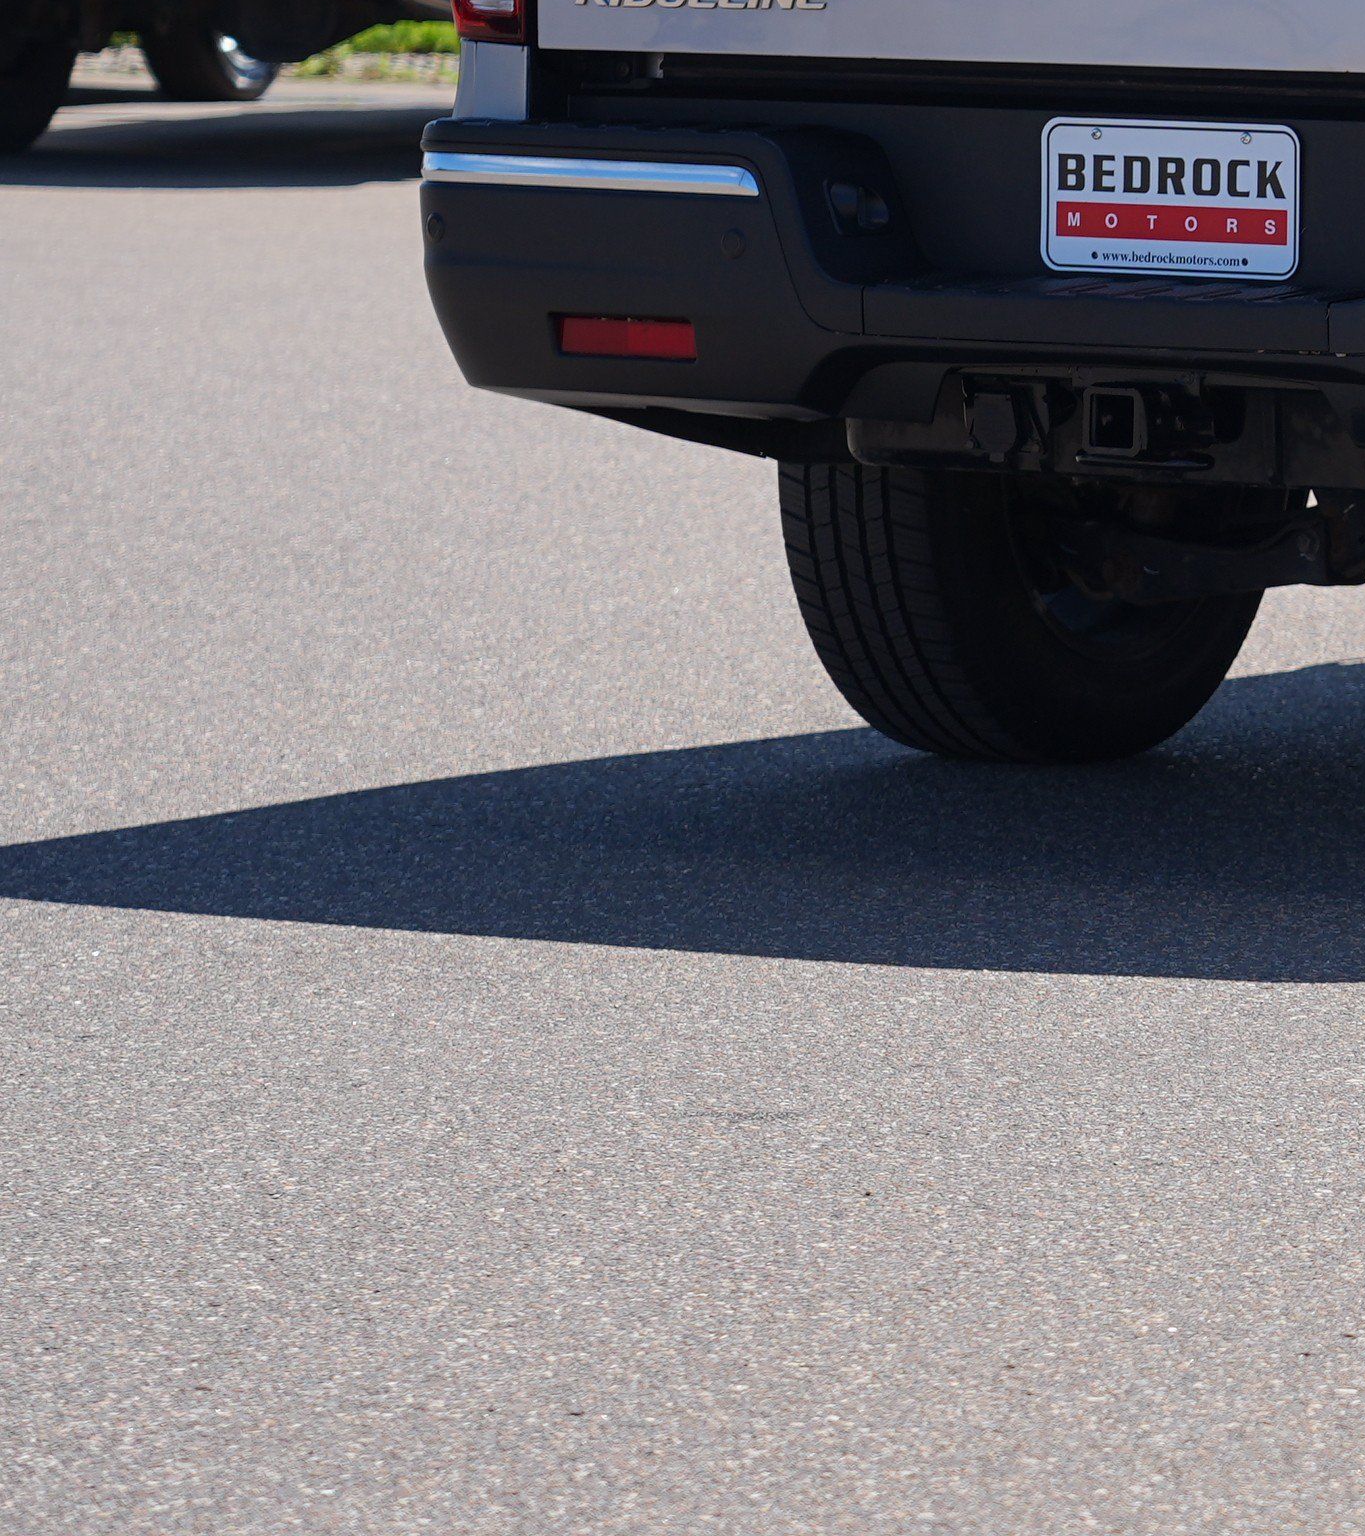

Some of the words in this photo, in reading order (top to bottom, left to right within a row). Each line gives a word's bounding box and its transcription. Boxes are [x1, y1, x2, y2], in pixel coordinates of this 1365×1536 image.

[1057, 152, 1287, 199] BEDROCK
[1067, 211, 1277, 236] MOTORS
[1102, 250, 1241, 267] www.bedrockmotors.com
